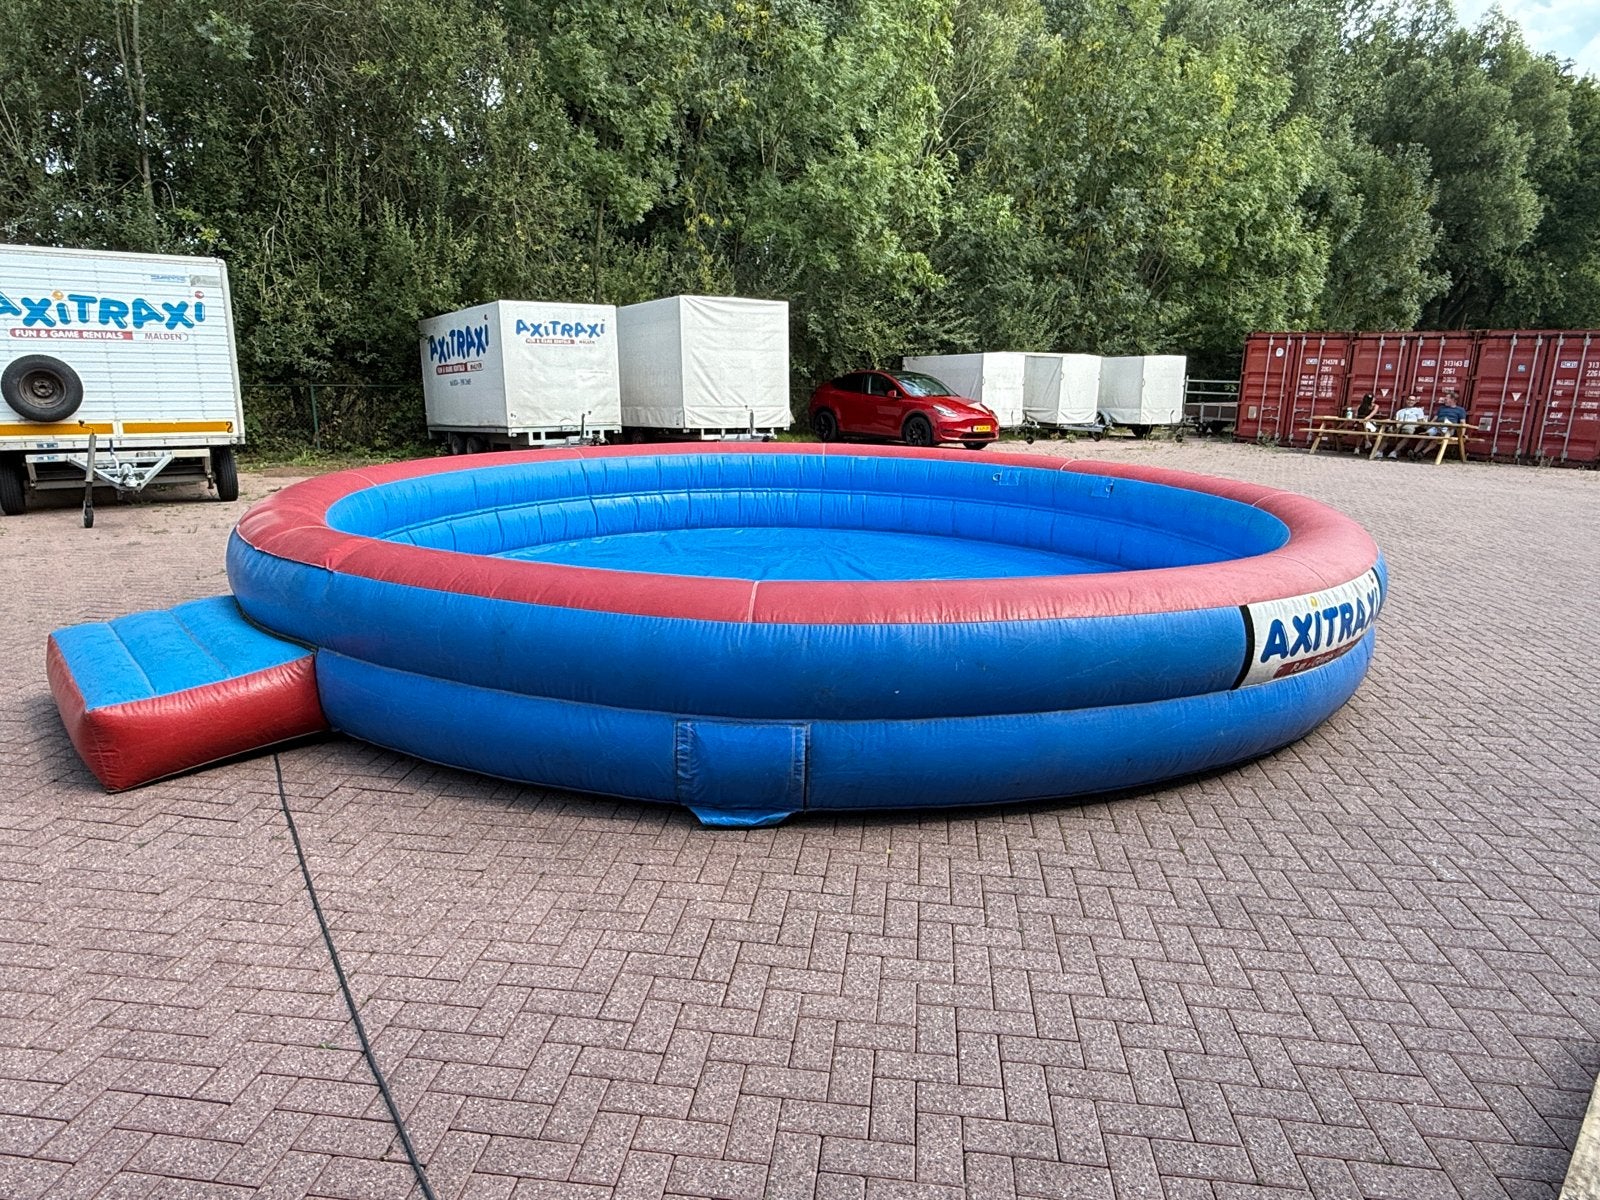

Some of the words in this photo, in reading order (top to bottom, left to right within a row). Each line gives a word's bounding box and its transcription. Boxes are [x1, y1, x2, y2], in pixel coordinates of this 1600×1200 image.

[15, 329, 37, 338] FUN
[39, 330, 48, 338] &
[50, 330, 80, 339] GAME
[82, 331, 124, 340] RENTALS
[144, 332, 183, 341] MALDEN
